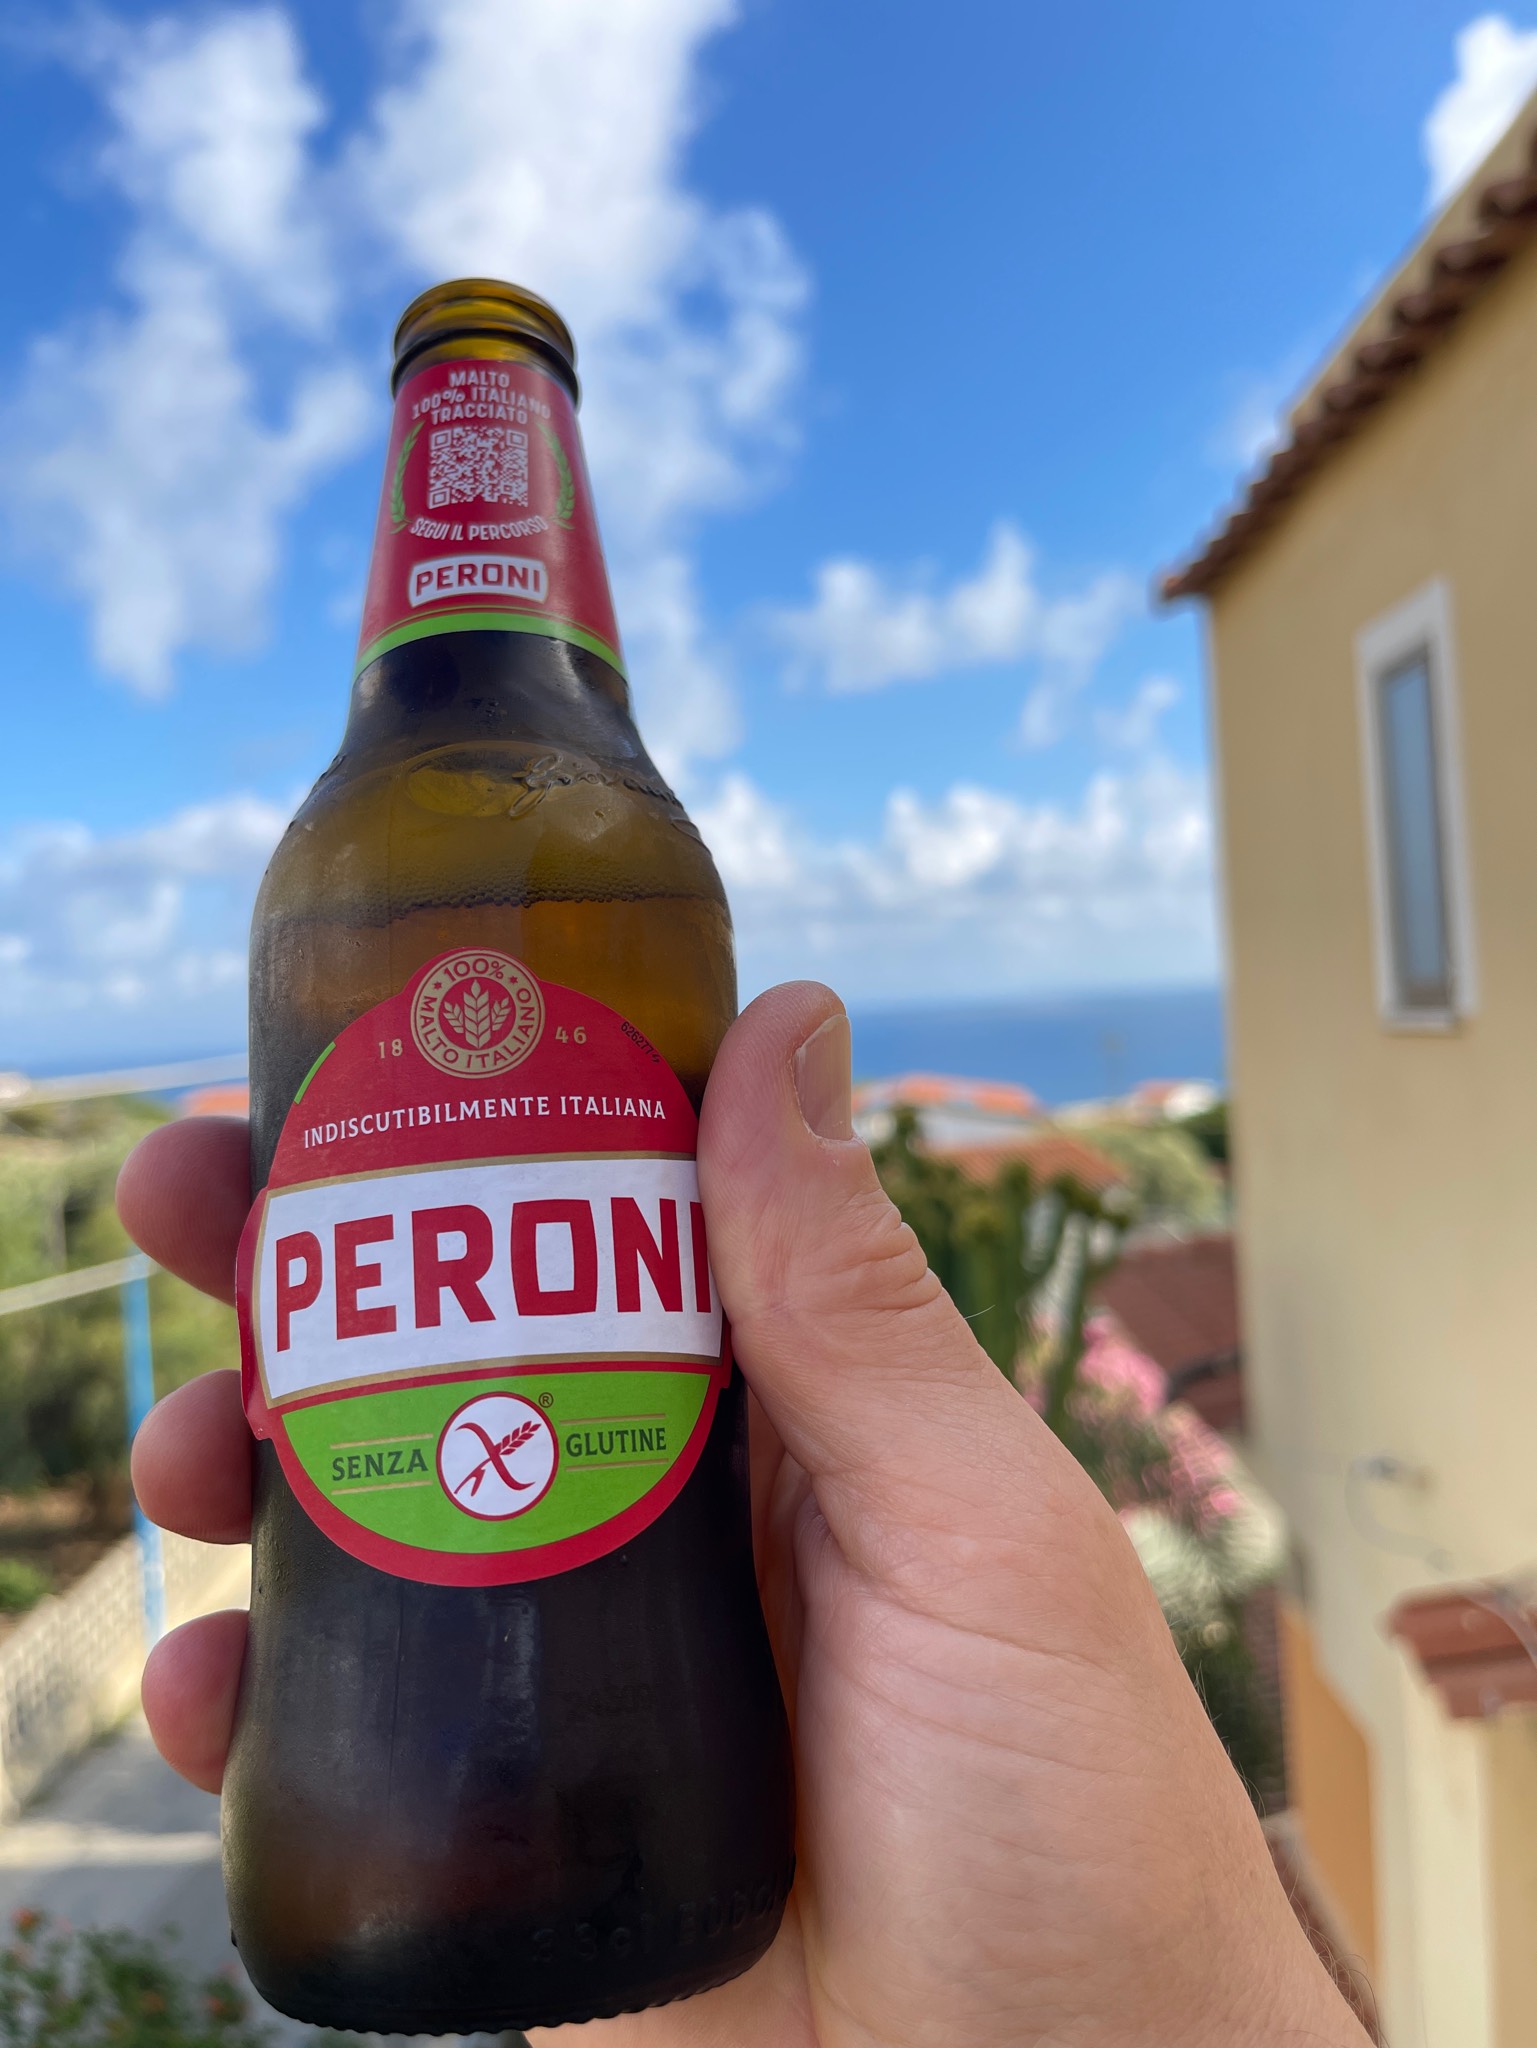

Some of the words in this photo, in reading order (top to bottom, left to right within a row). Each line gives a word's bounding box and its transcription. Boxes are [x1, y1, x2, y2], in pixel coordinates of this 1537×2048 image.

[449, 368, 510, 388] MALTO
[412, 388, 465, 420] 100%
[471, 386, 551, 420] ITALIANO
[430, 403, 529, 426] TRACCIATO
[410, 517, 450, 541] SEGUI
[450, 524, 464, 541] IL
[468, 515, 549, 541] PERCORSO
[415, 562, 542, 598] PERONI
[443, 957, 505, 984] 100%
[376, 1038, 403, 1060] 18
[554, 1026, 588, 1045] 46
[419, 995, 460, 1065] MALTO
[466, 987, 535, 1069] ITALIANO
[302, 1096, 551, 1149] INDISCUTIBILMENTE
[560, 1096, 667, 1120] ITALIANA
[275, 1196, 712, 1353] PERONI
[331, 1448, 428, 1481] SENZA
[566, 1426, 668, 1457] GLUTINE
